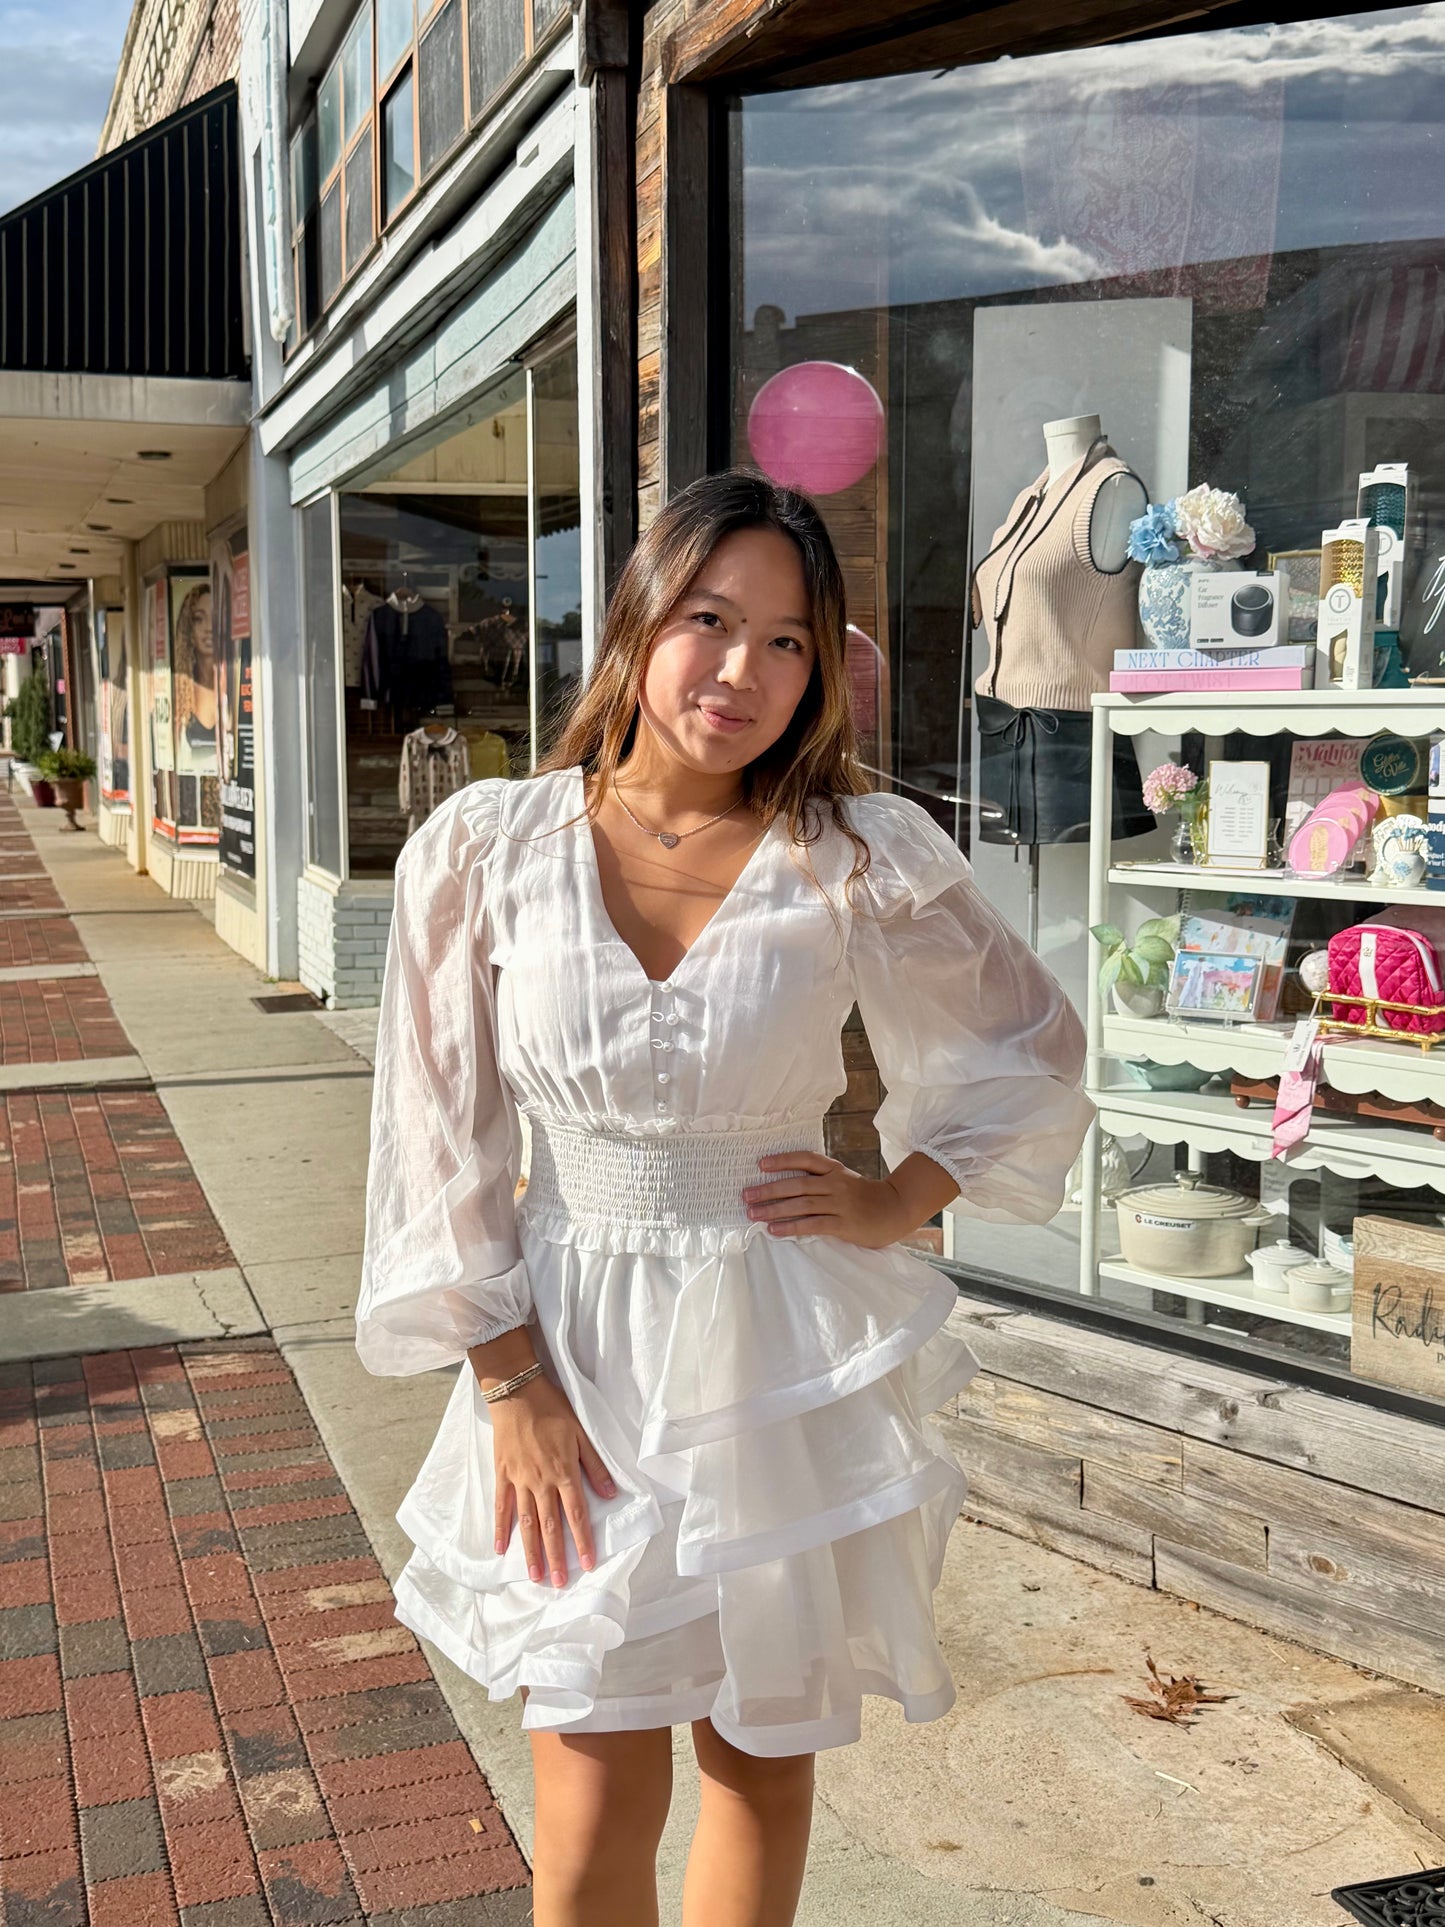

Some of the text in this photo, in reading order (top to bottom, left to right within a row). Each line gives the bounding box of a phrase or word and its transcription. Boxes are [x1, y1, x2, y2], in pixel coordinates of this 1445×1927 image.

[1128, 650, 1260, 669] NEXT CHAPTER
[1154, 1220, 1192, 1229] CREUSET
